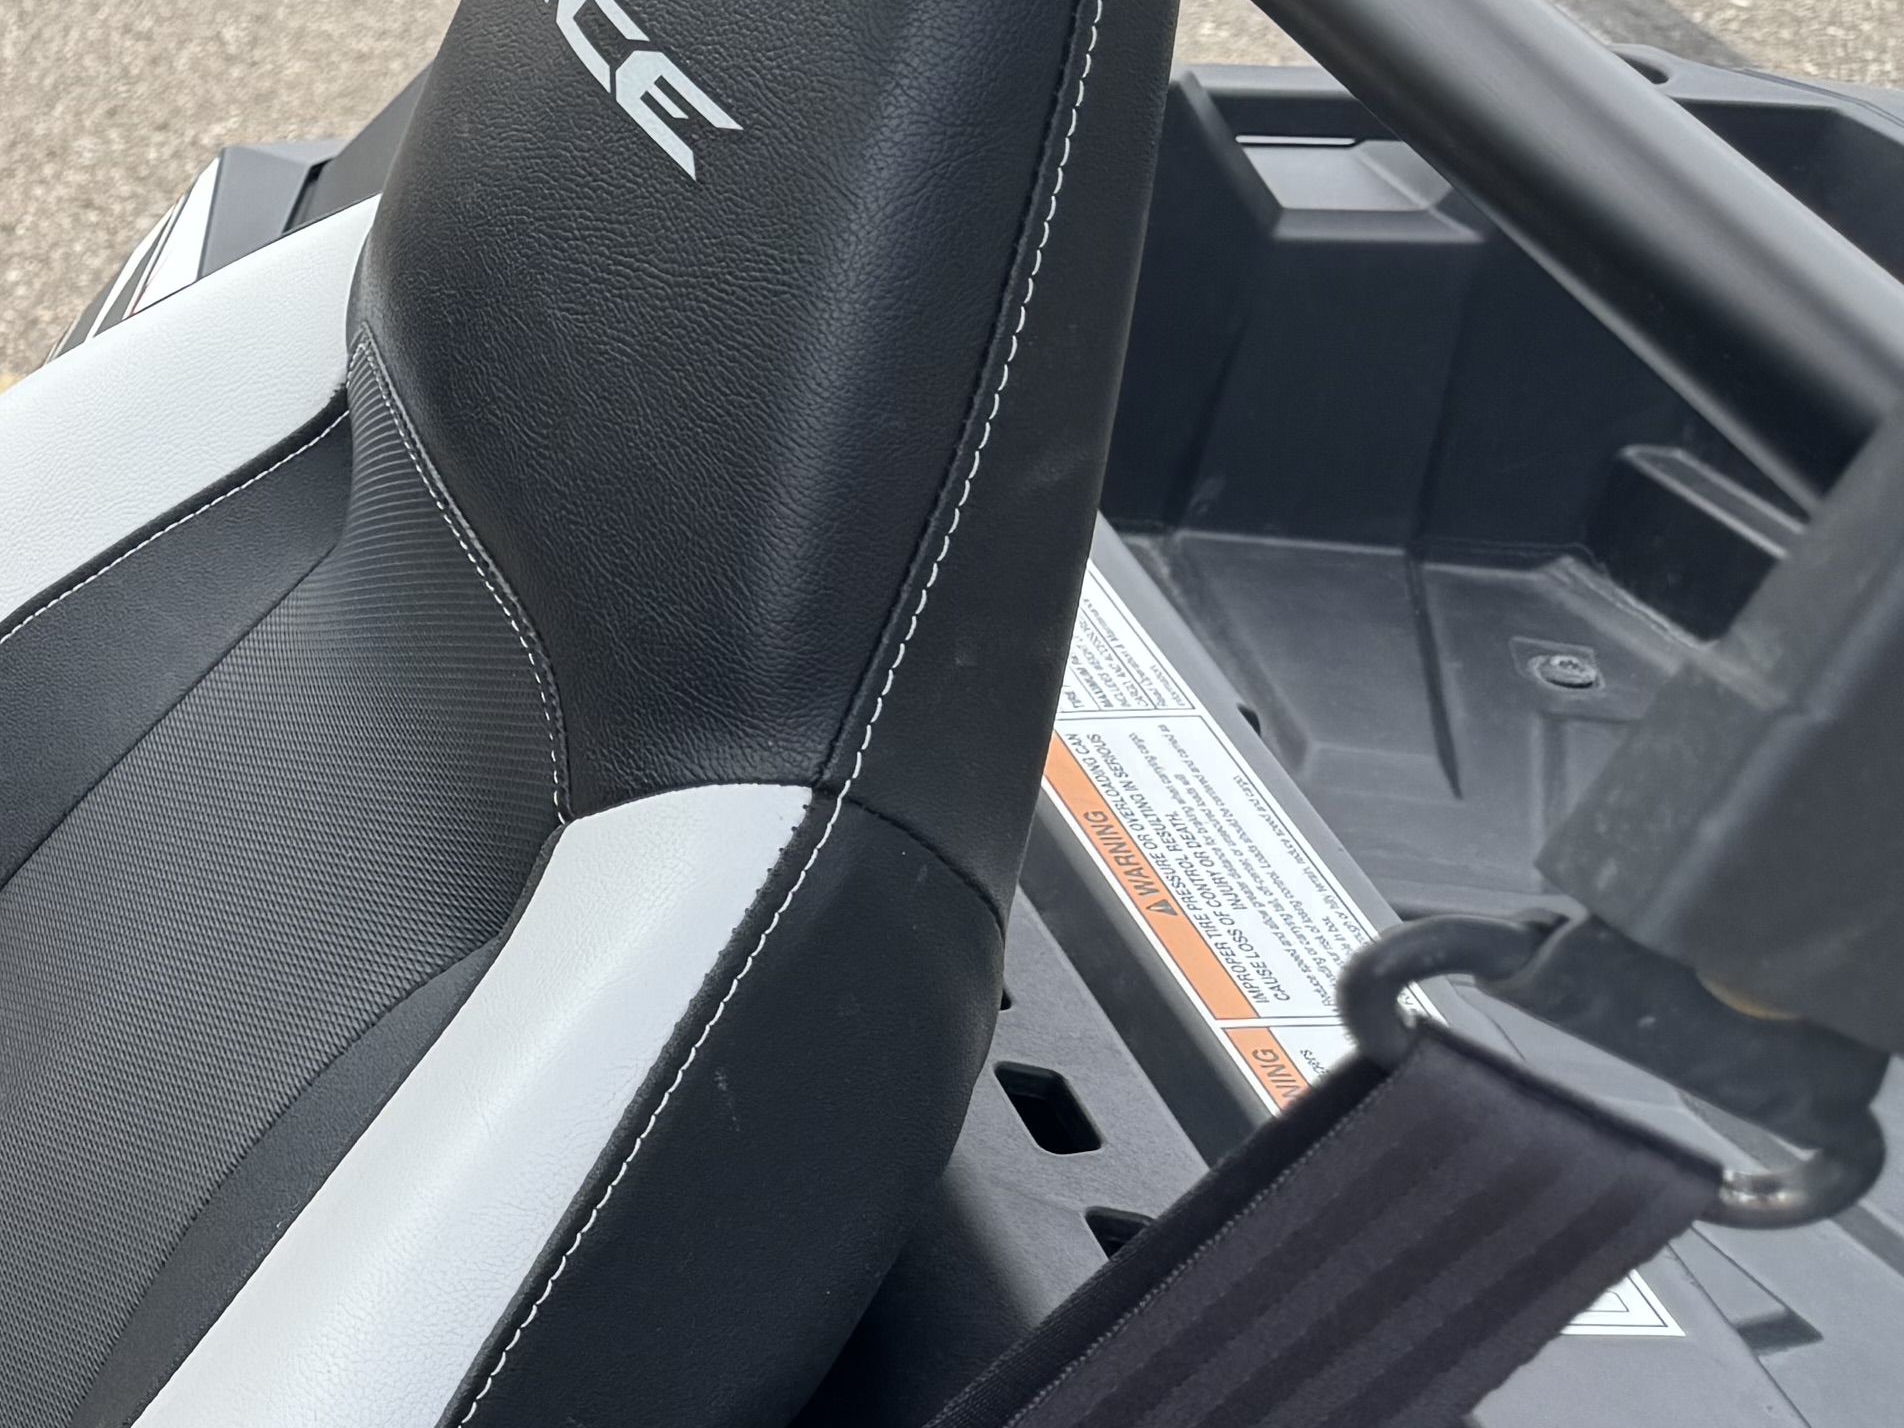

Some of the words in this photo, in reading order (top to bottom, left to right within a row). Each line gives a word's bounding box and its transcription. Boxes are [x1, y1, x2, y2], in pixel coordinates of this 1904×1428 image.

[1065, 733, 1092, 754] CAN
[1085, 733, 1130, 777] SERIOUS
[1081, 757, 1147, 830] OVERLOADING
[1119, 780, 1139, 790] IN
[1129, 793, 1184, 851] RESULTING
[1136, 834, 1160, 849] OR
[1163, 811, 1203, 847] DEATH.
[1082, 810, 1163, 896] WARNING
[1192, 851, 1216, 867] OR
[1149, 852, 1204, 910] PRESSURE
[1171, 853, 1225, 907] CONTROL
[1206, 870, 1248, 909] INJURY
[1193, 913, 1224, 938] TIRE
[1213, 910, 1237, 925] OF
[1226, 928, 1261, 958] LOSS
[1214, 942, 1271, 1002] IMPROPER
[1250, 961, 1292, 1000] CAUSE
[1252, 1048, 1307, 1097] NING
